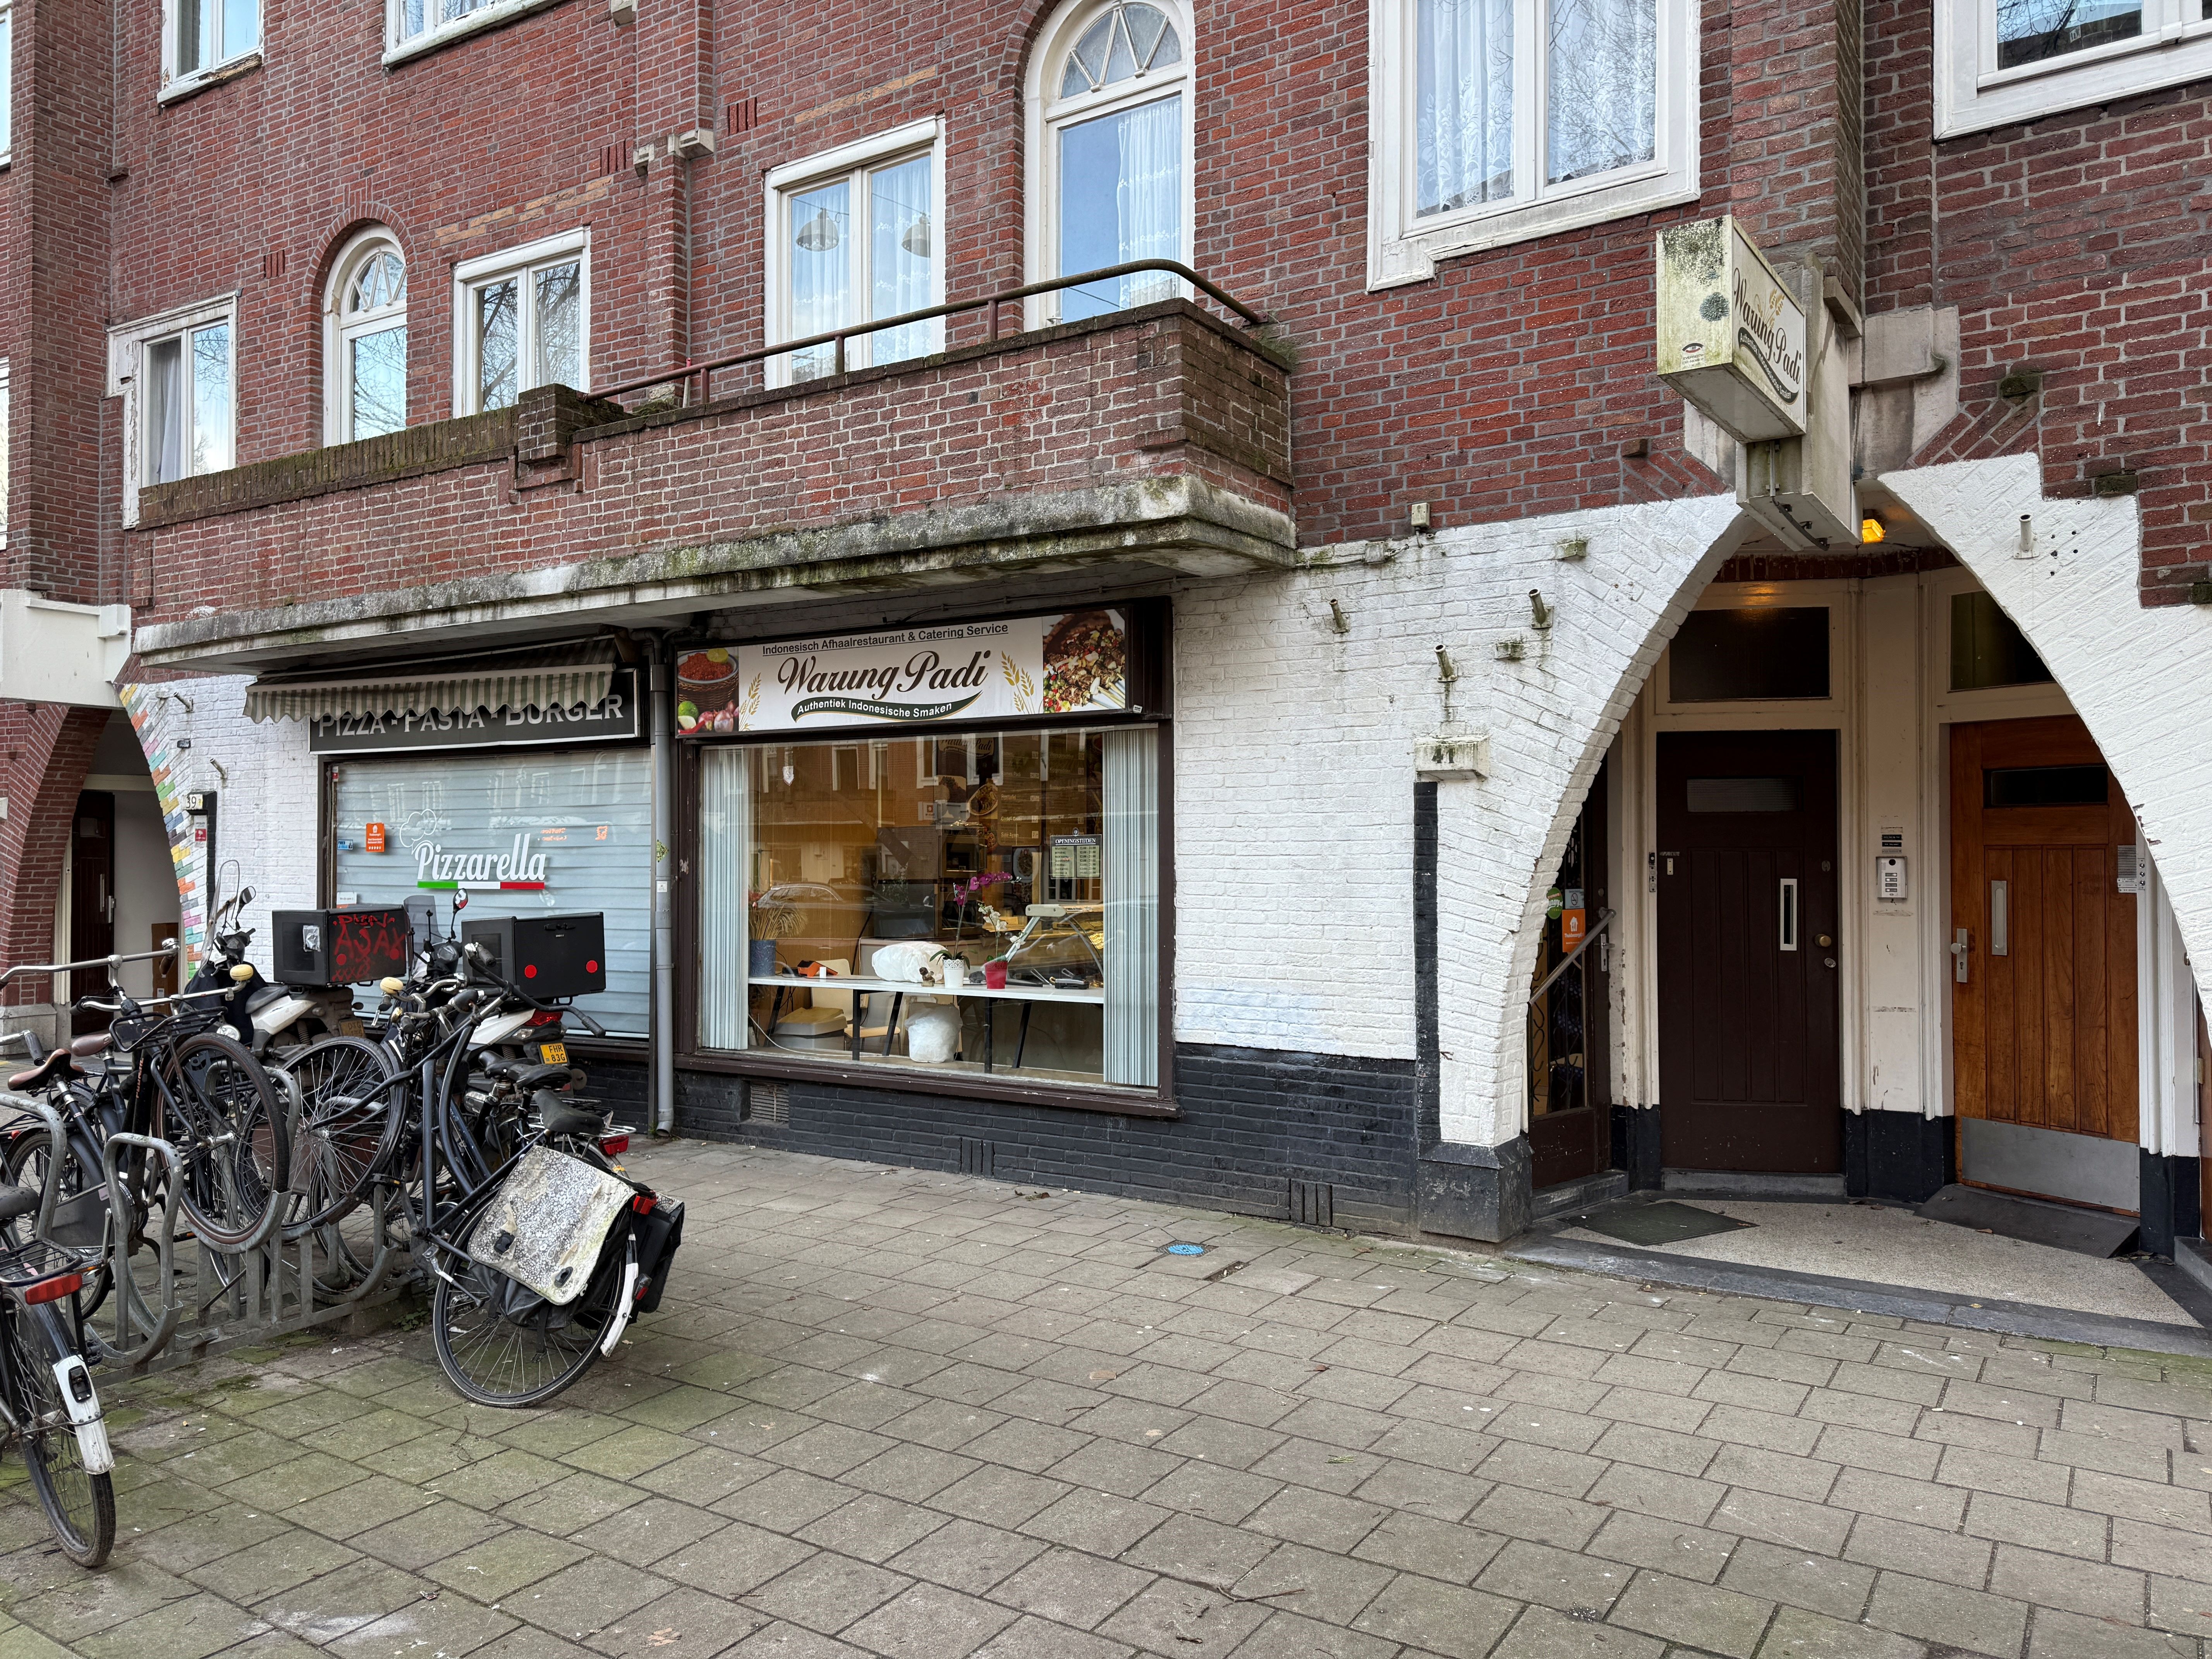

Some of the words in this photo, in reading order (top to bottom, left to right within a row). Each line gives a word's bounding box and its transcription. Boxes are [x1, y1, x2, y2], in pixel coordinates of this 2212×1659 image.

[1734, 268, 1774, 362] Warung
[1774, 328, 1801, 385] Padi
[763, 641, 819, 655] Indonesisch
[821, 632, 905, 650] Afhaalrestaurant
[908, 632, 916, 641] &
[918, 627, 963, 640] Catering
[967, 623, 1008, 636] Service
[778, 655, 900, 700] Warung
[896, 650, 992, 693] Padi
[319, 713, 386, 737] PIZZA
[404, 709, 485, 732] PASTA
[505, 694, 623, 726] BURGER
[797, 699, 846, 715] Authentiek
[848, 700, 910, 717] Indonesische
[913, 701, 952, 718] Smaken
[1431, 748, 1455, 764] 41
[186, 795, 197, 809] 39
[415, 833, 546, 881] Pizzarella
[334, 924, 406, 962] AJAX
[548, 1044, 563, 1053] FHR
[551, 1053, 565, 1062] 83G
